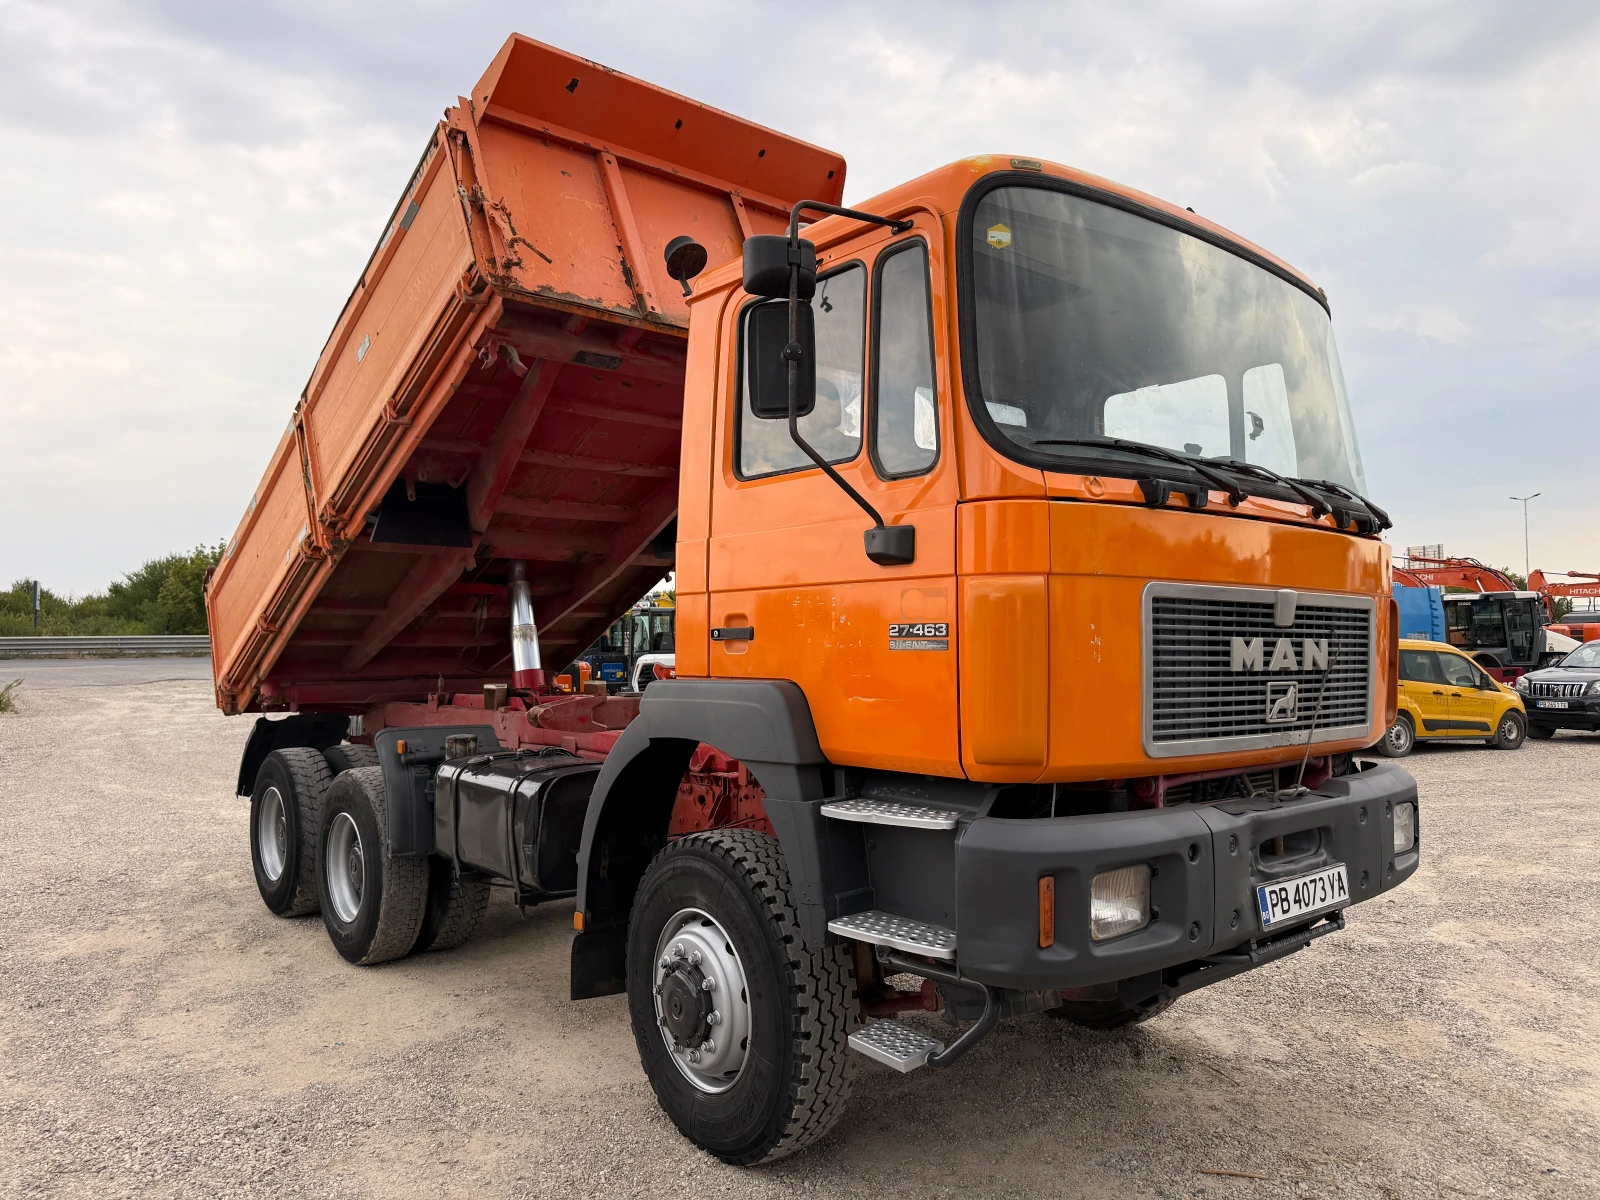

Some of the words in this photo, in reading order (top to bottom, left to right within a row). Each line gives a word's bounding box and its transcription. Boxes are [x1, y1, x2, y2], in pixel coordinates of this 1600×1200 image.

[889, 641, 928, 649] SILENT
[1230, 637, 1328, 671] MAN
[1268, 886, 1291, 918] PB
[1293, 876, 1327, 910] 4073
[1327, 870, 1347, 900] YA
[1262, 911, 1270, 920] BG
